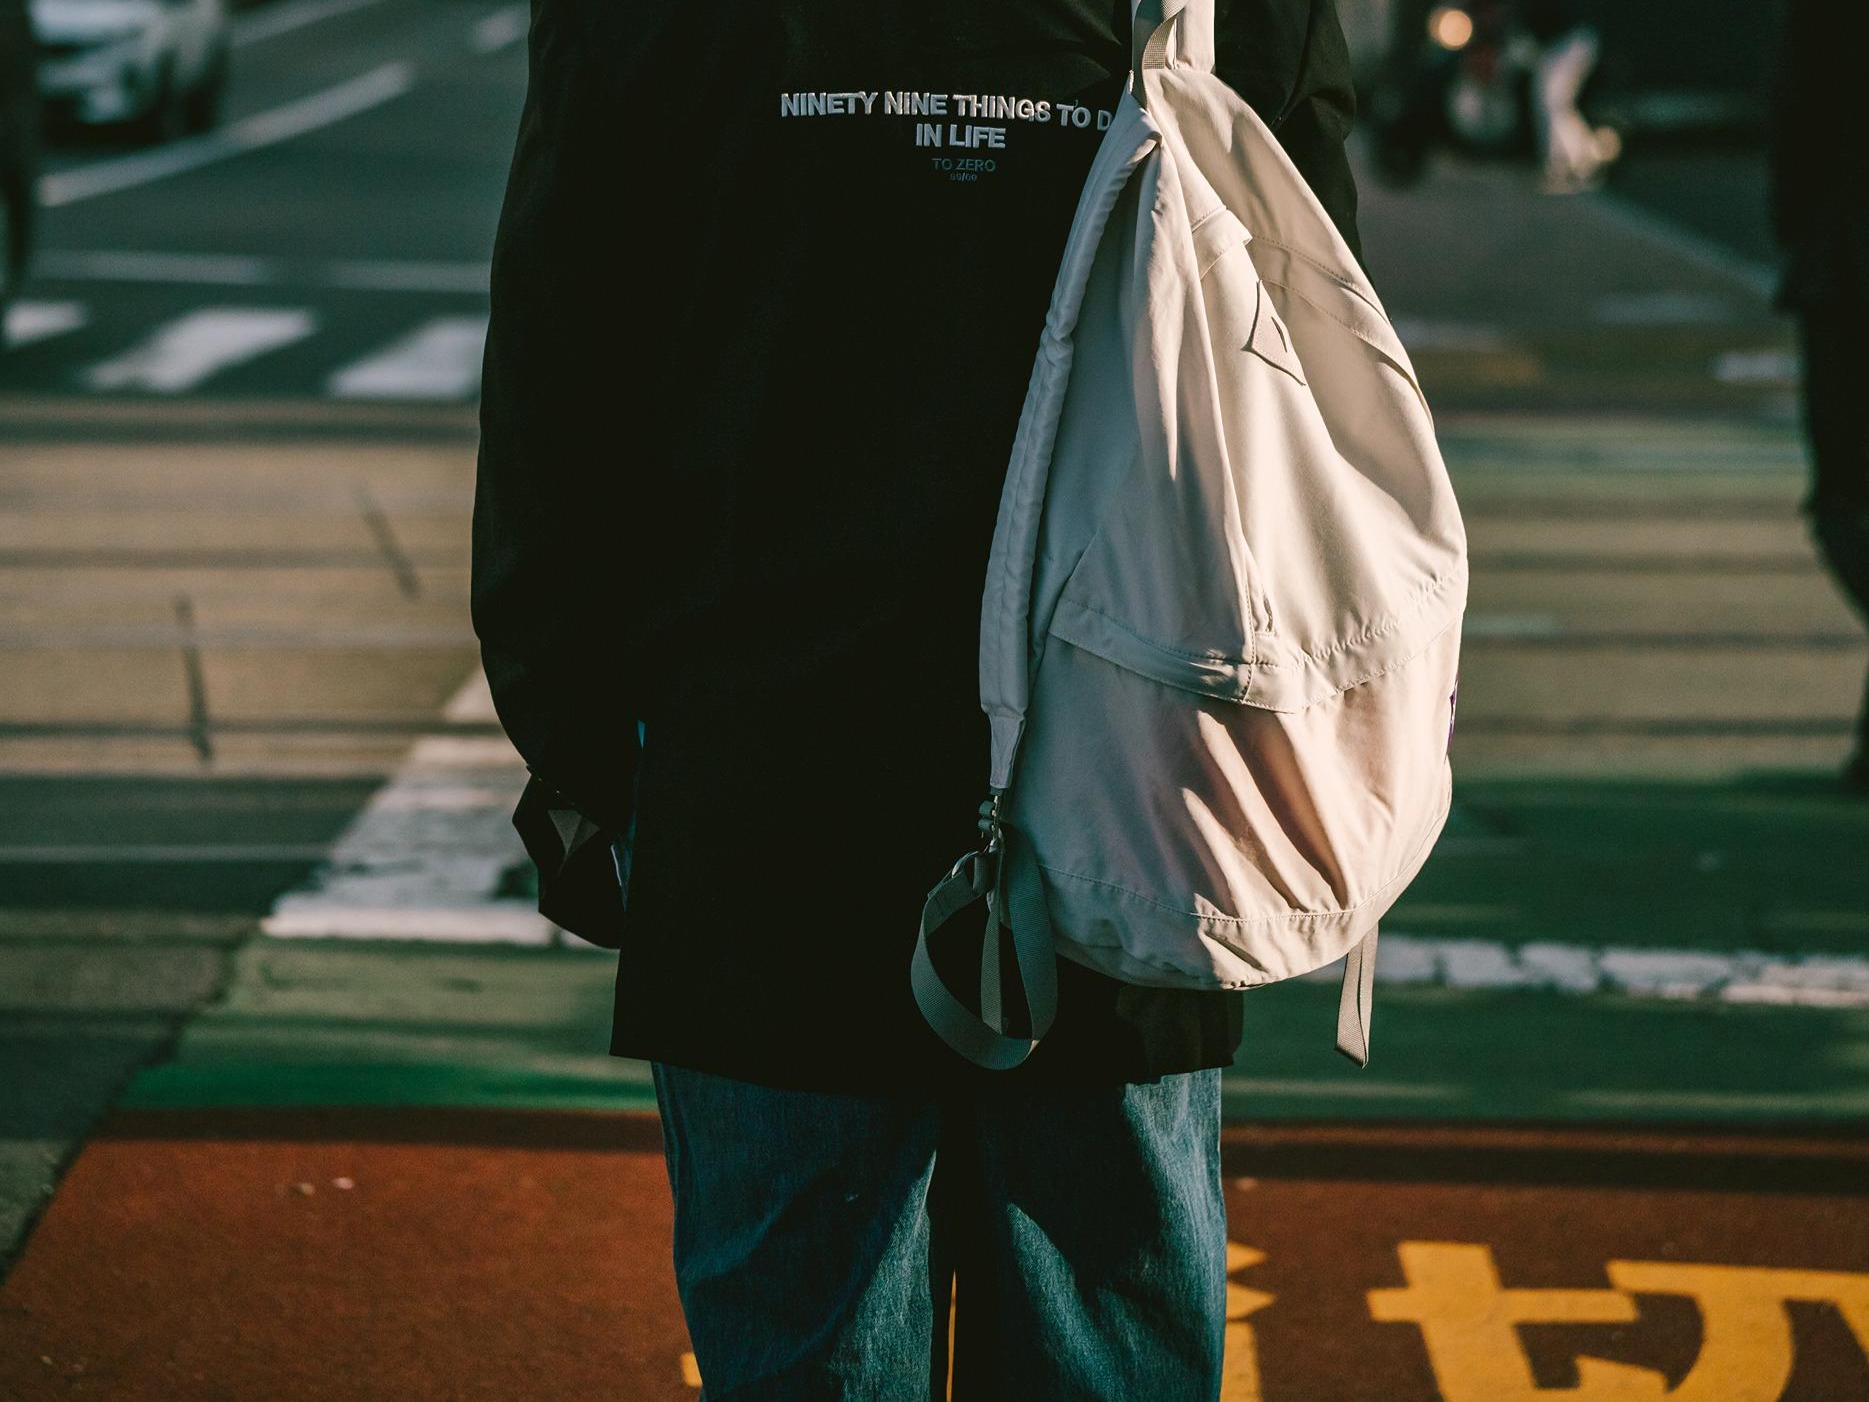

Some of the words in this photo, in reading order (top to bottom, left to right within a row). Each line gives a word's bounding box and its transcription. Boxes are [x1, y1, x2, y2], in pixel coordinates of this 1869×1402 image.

[780, 91, 878, 118] NINETY
[884, 91, 948, 116] NINE
[952, 93, 1051, 122] THINGS
[1056, 103, 1092, 129] TO
[1096, 109, 1113, 131] D
[915, 123, 942, 148] IN
[949, 124, 1006, 149] LIFE
[931, 157, 953, 171] TO
[955, 158, 996, 172] ZERO
